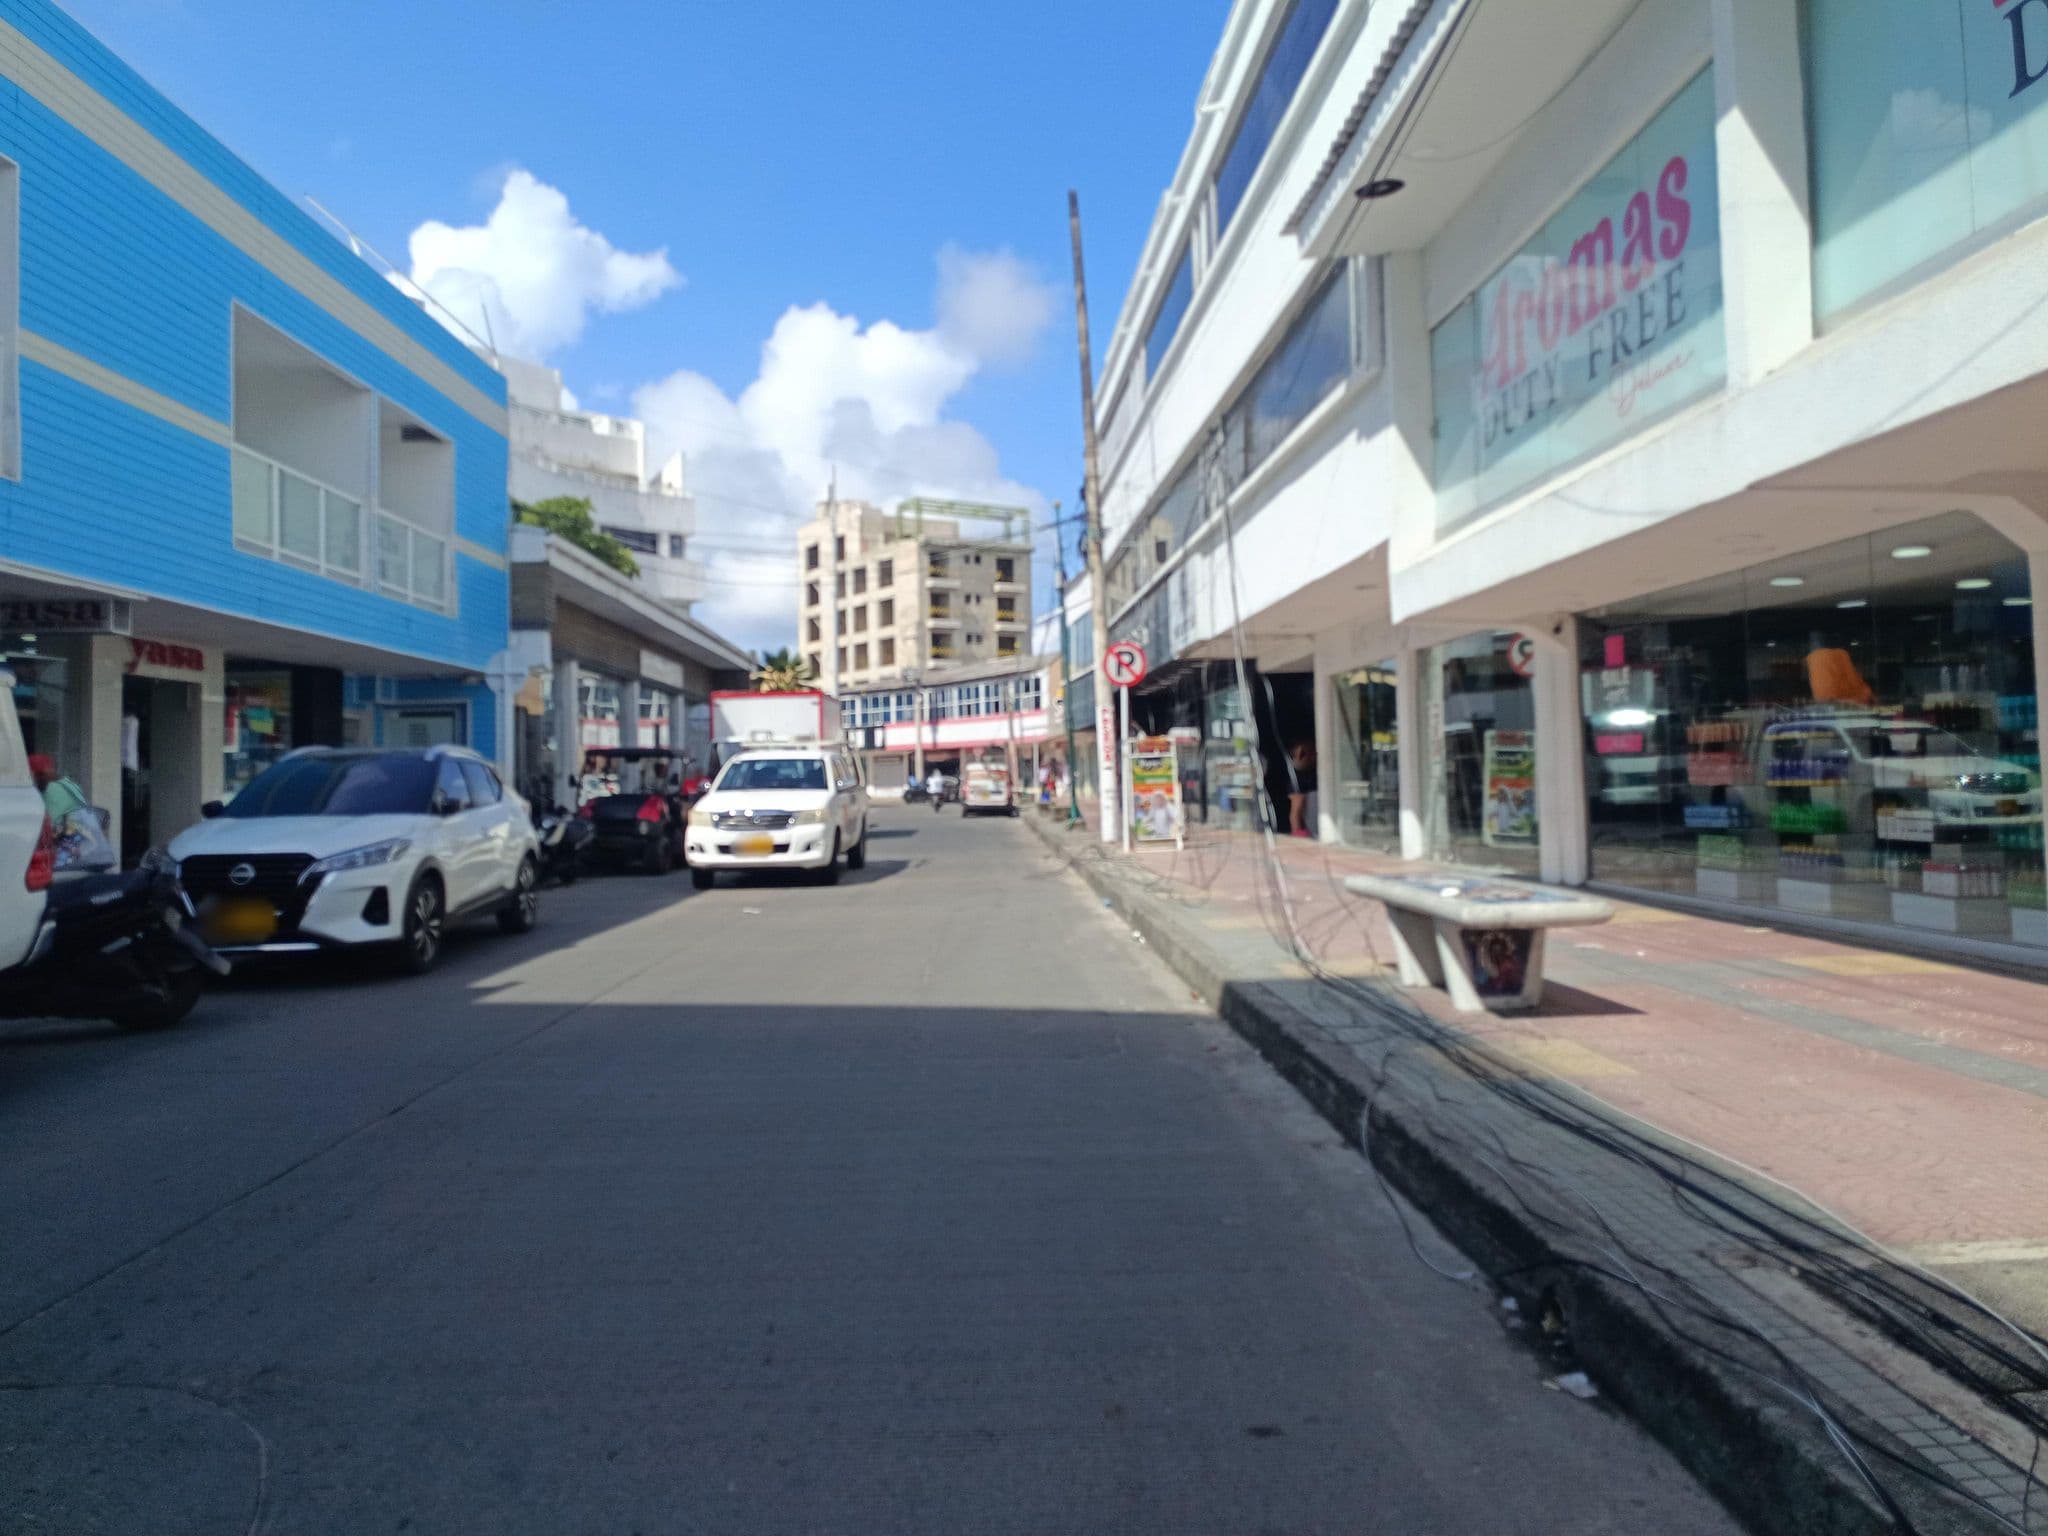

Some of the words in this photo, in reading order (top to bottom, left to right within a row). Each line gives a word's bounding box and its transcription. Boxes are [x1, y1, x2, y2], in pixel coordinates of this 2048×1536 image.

[1480, 156, 1692, 392] Aromas
[1482, 352, 1561, 449] DUTY
[1588, 262, 1687, 382] FREE
[126, 637, 206, 674] yasa
[1116, 651, 1134, 677] P
